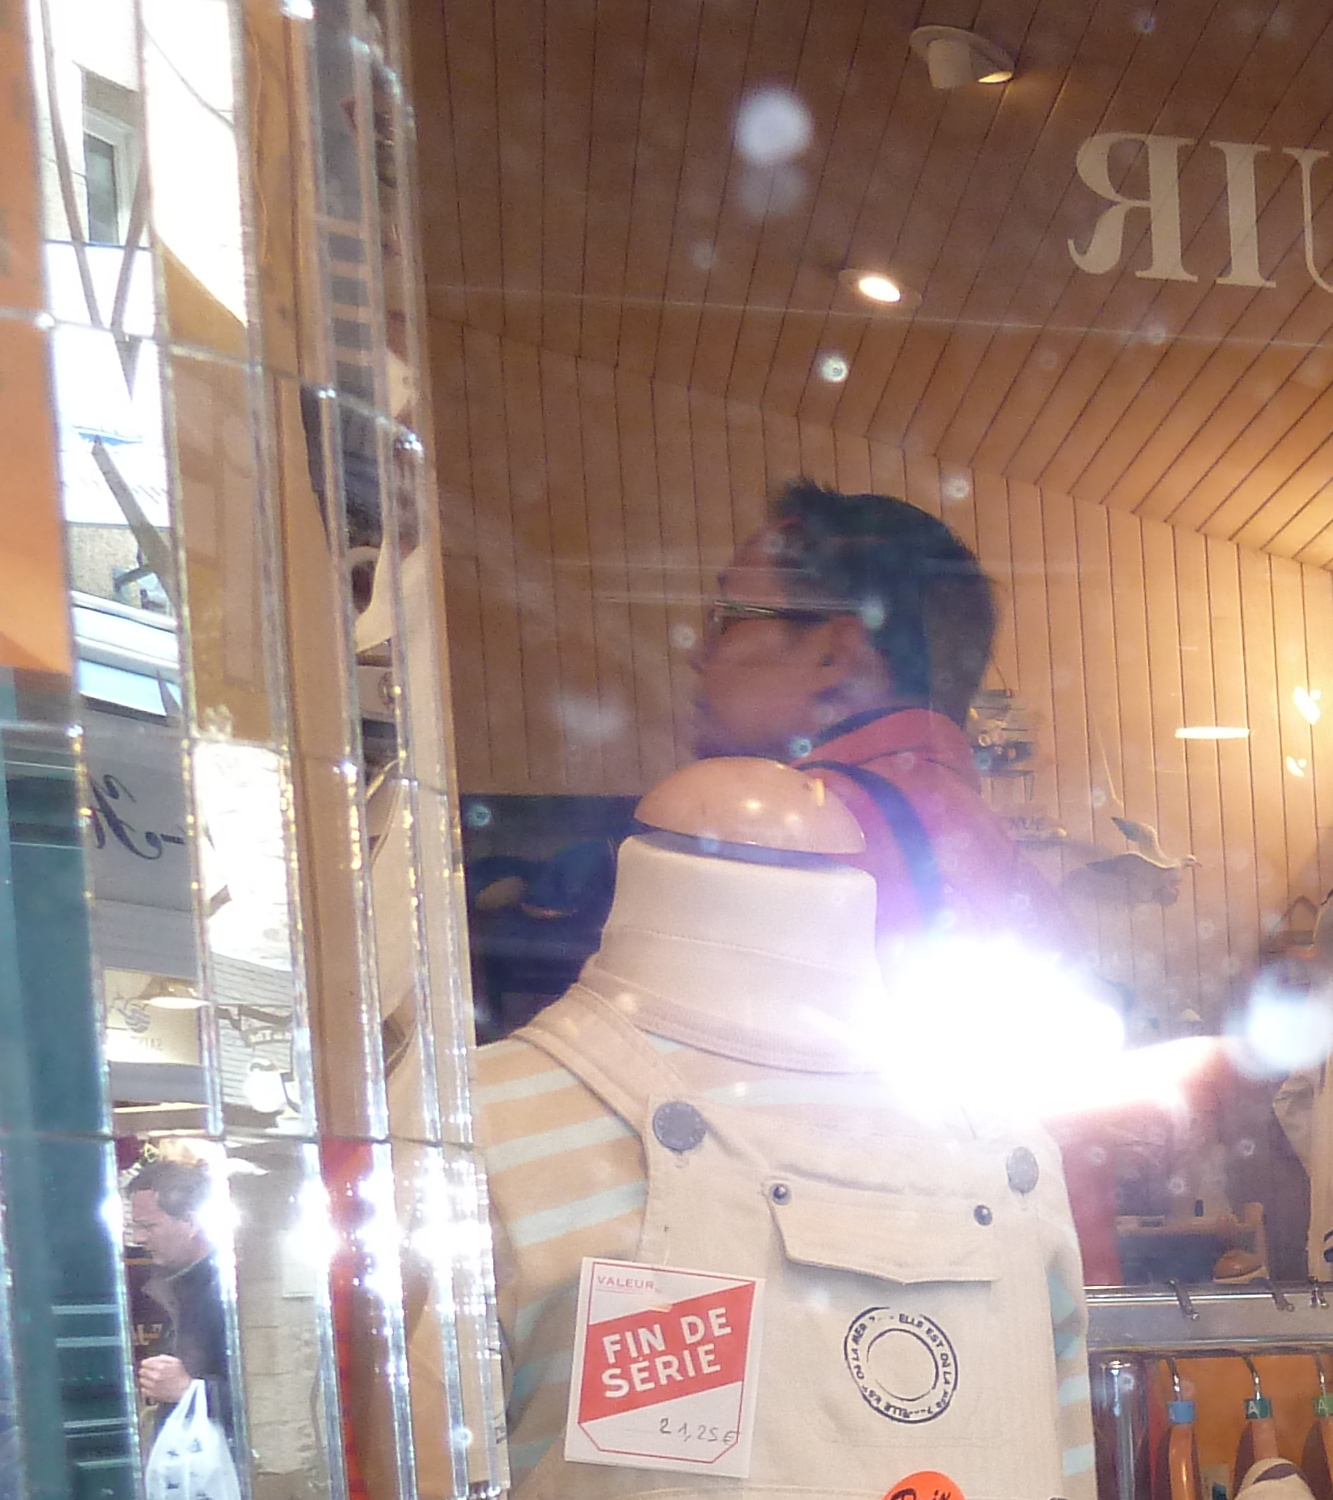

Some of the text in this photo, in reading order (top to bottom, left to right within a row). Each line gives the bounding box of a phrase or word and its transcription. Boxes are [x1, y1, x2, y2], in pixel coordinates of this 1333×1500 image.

[602, 1307, 732, 1364] FIN DE
[601, 1343, 722, 1399] SÉRIE
